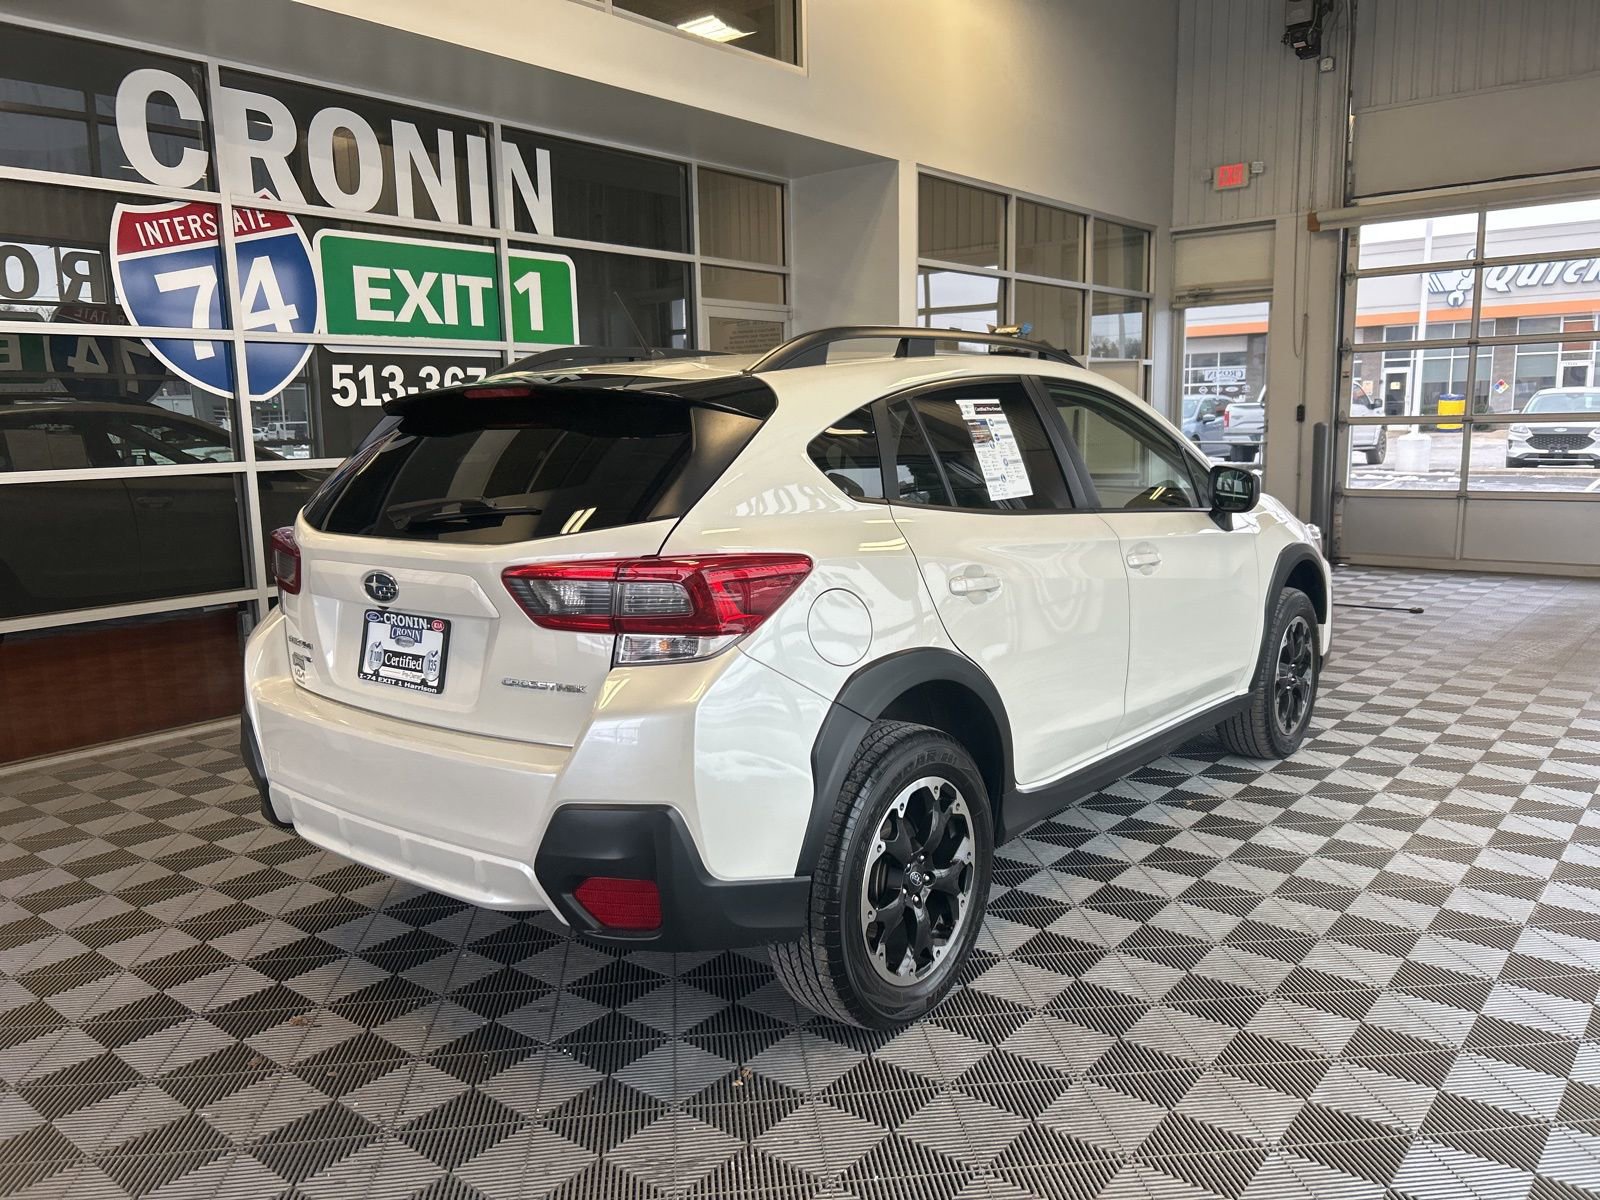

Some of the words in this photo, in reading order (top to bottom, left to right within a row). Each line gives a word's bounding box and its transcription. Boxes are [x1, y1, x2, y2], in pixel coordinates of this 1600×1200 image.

[115, 68, 554, 237] CRONIN
[135, 206, 272, 247] INTERSATE
[154, 255, 299, 361] 74
[352, 264, 493, 327] EXIT
[513, 271, 544, 332] 1
[384, 613, 427, 629] CRONIN
[391, 627, 421, 642] CRONIN
[385, 652, 422, 670] Certified
[359, 673, 376, 681] I-74
[378, 677, 396, 685] EXIT
[404, 682, 437, 693] Harrison
